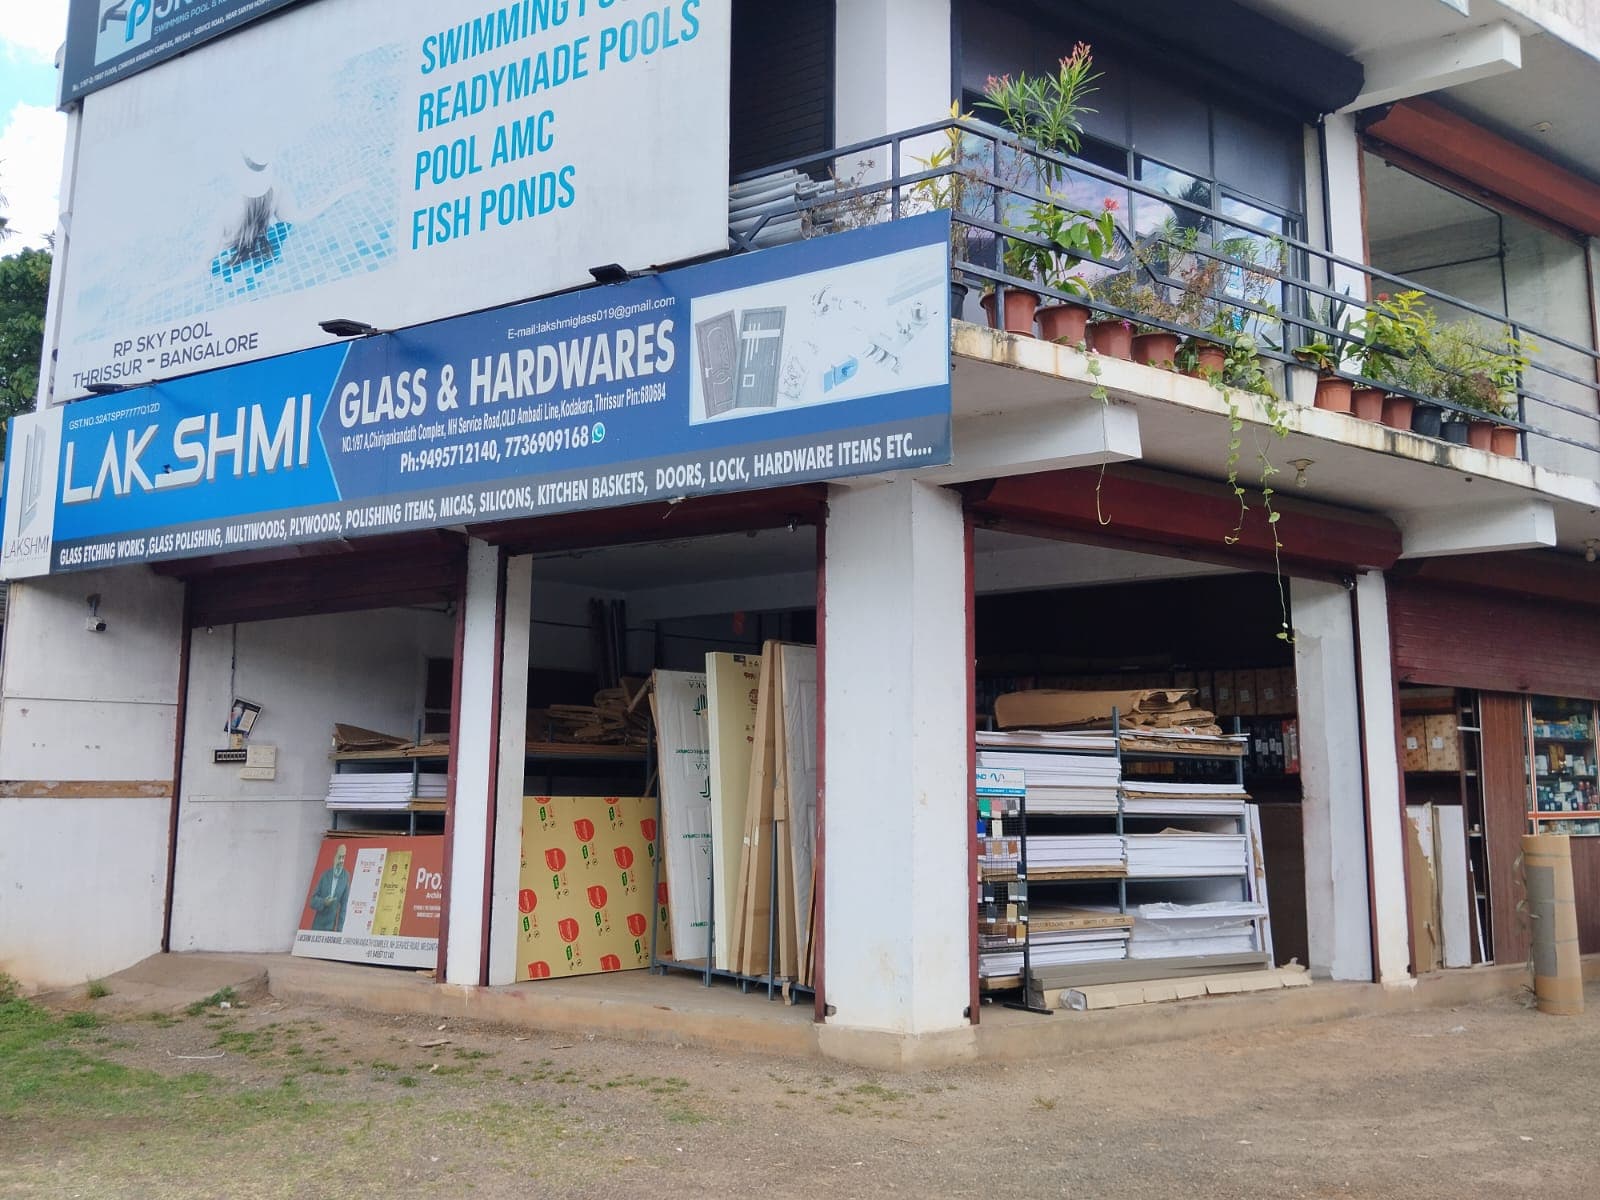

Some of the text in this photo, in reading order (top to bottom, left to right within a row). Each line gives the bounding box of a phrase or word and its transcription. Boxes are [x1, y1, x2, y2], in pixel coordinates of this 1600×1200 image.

[154, 12, 190, 35] SWIMMING
[190, 5, 210, 19] POOL
[420, 0, 569, 75] SWIMMING
[417, 0, 700, 133] READYMADE POOLS
[414, 109, 554, 191] POOL AMC
[412, 165, 575, 250] FISH PONDS
[113, 321, 212, 359] RP SKY POOL
[507, 296, 675, 339] E-mail:lakshmiglass019@gmail.com
[73, 358, 142, 388] THRISSUR
[160, 332, 259, 369] BANGALORE
[339, 319, 675, 428] GLASS & HARDWARES
[62, 394, 312, 504] LAKSHMI
[401, 425, 589, 473] Ph:9495712140, 7736909168
[448, 418, 457, 435] NH
[458, 415, 482, 434] Service
[517, 403, 543, 424] Ambadi
[60, 547, 82, 566] GLASS
[83, 542, 116, 564] ETCHING
[117, 538, 145, 559] WORKS
[175, 528, 223, 551] POLISHING,
[225, 519, 288, 545] MULTIWOODS,
[289, 511, 342, 536] PLYWOODS,
[345, 504, 401, 530] POLISHING
[404, 497, 437, 523] ITEMS,
[440, 493, 477, 519] MICAS,
[479, 486, 534, 513] SILICONS,
[537, 479, 588, 506] KITCHEN
[592, 470, 648, 499] BASKETS,
[655, 463, 705, 491] DOORS,
[709, 457, 750, 484] LOCK,
[754, 445, 833, 477] HARDWARE
[838, 436, 881, 467] ITEMS
[415, 867, 443, 890] Pro
